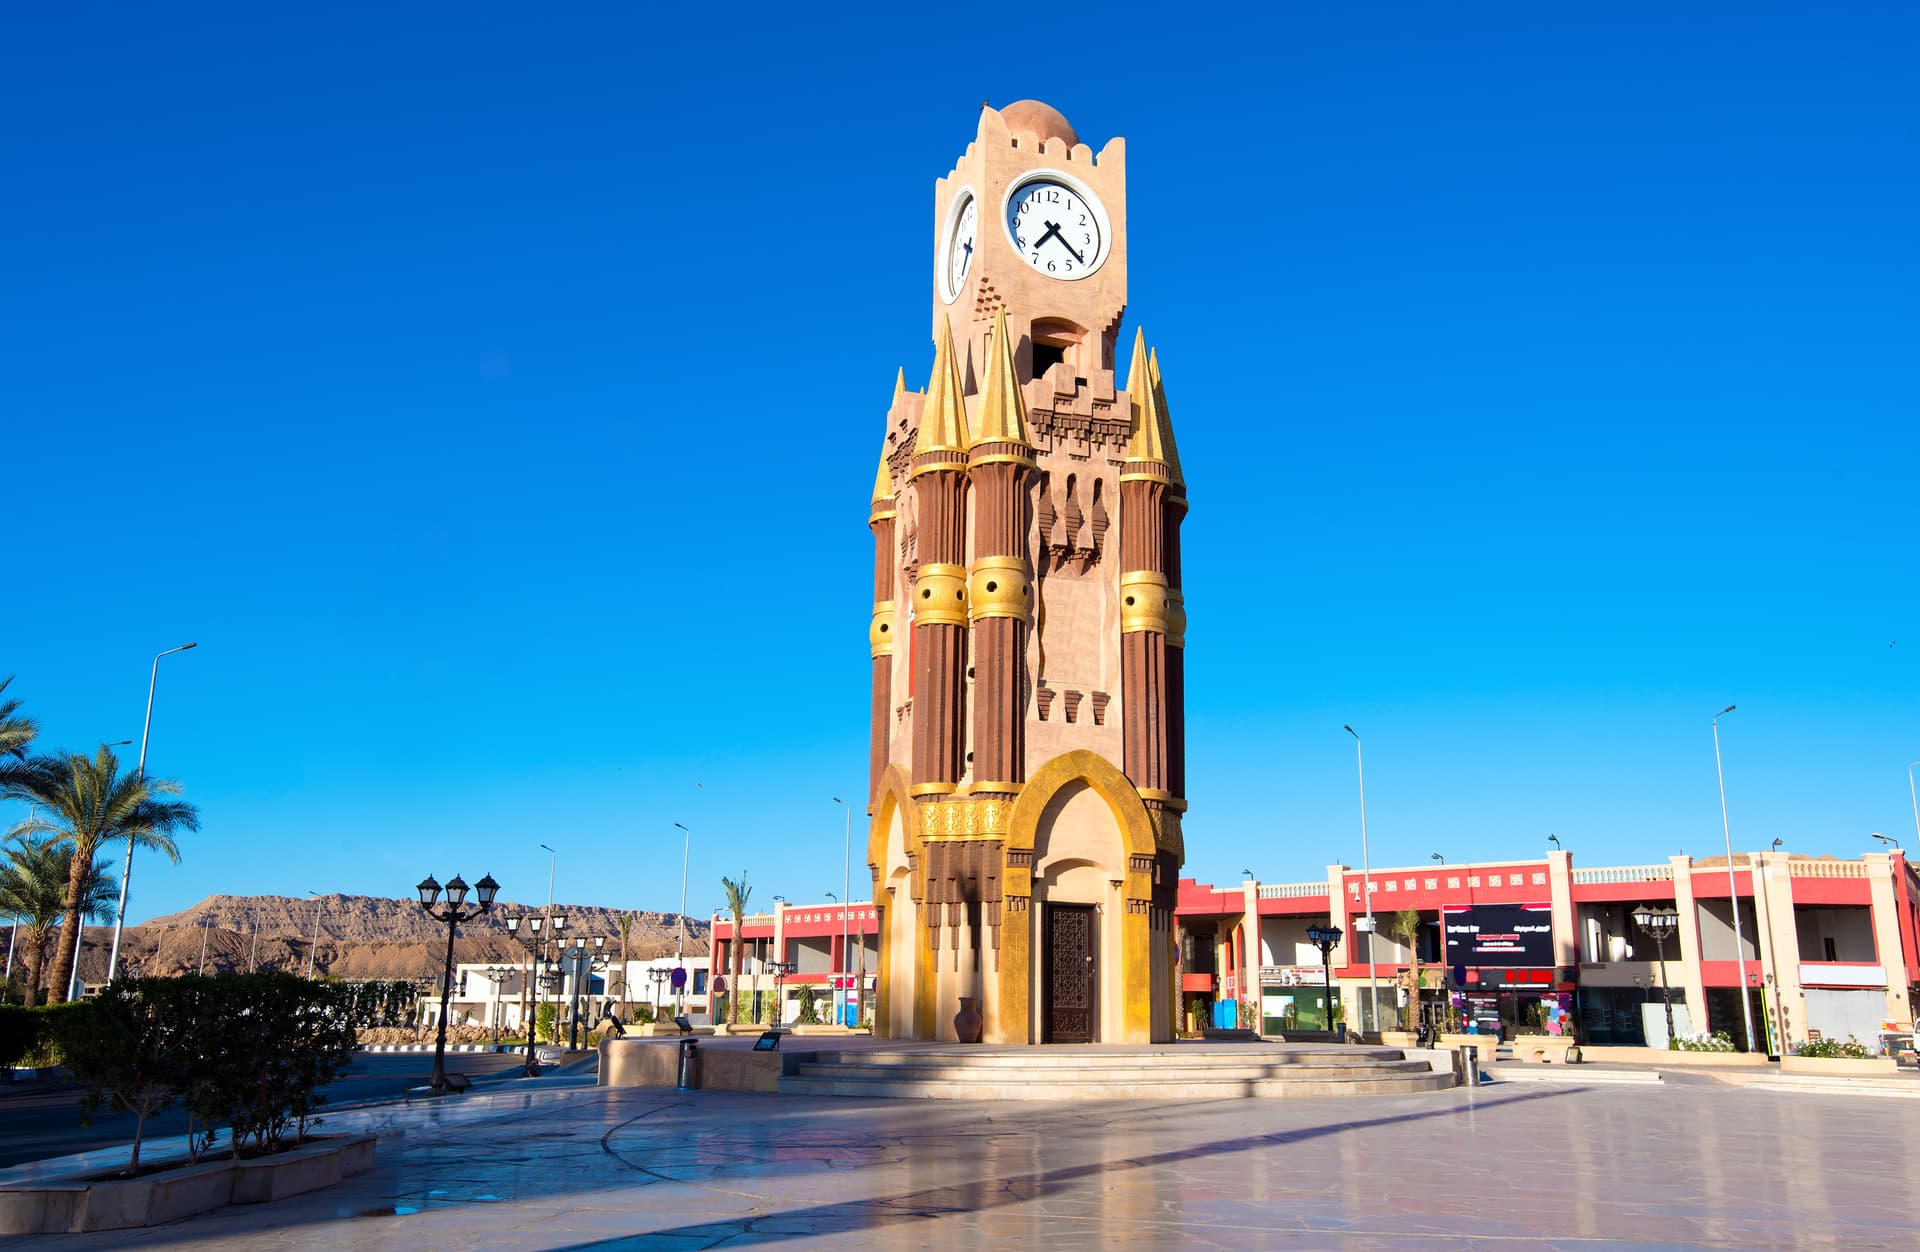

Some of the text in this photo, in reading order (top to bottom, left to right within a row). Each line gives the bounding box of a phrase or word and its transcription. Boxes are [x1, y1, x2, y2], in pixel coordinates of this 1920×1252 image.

[1031, 191, 1041, 203] 11
[1046, 190, 1060, 203] 12
[1016, 201, 1029, 214] 10
[1067, 199, 1072, 210] 1
[1013, 217, 1021, 228] 9
[1079, 214, 1086, 226] 2
[1018, 236, 1026, 248] 8
[1084, 233, 1090, 245] 3
[1032, 252, 1039, 264] 7
[1078, 250, 1084, 259] 4
[1047, 260, 1056, 272] 6
[1065, 260, 1072, 271] 5
